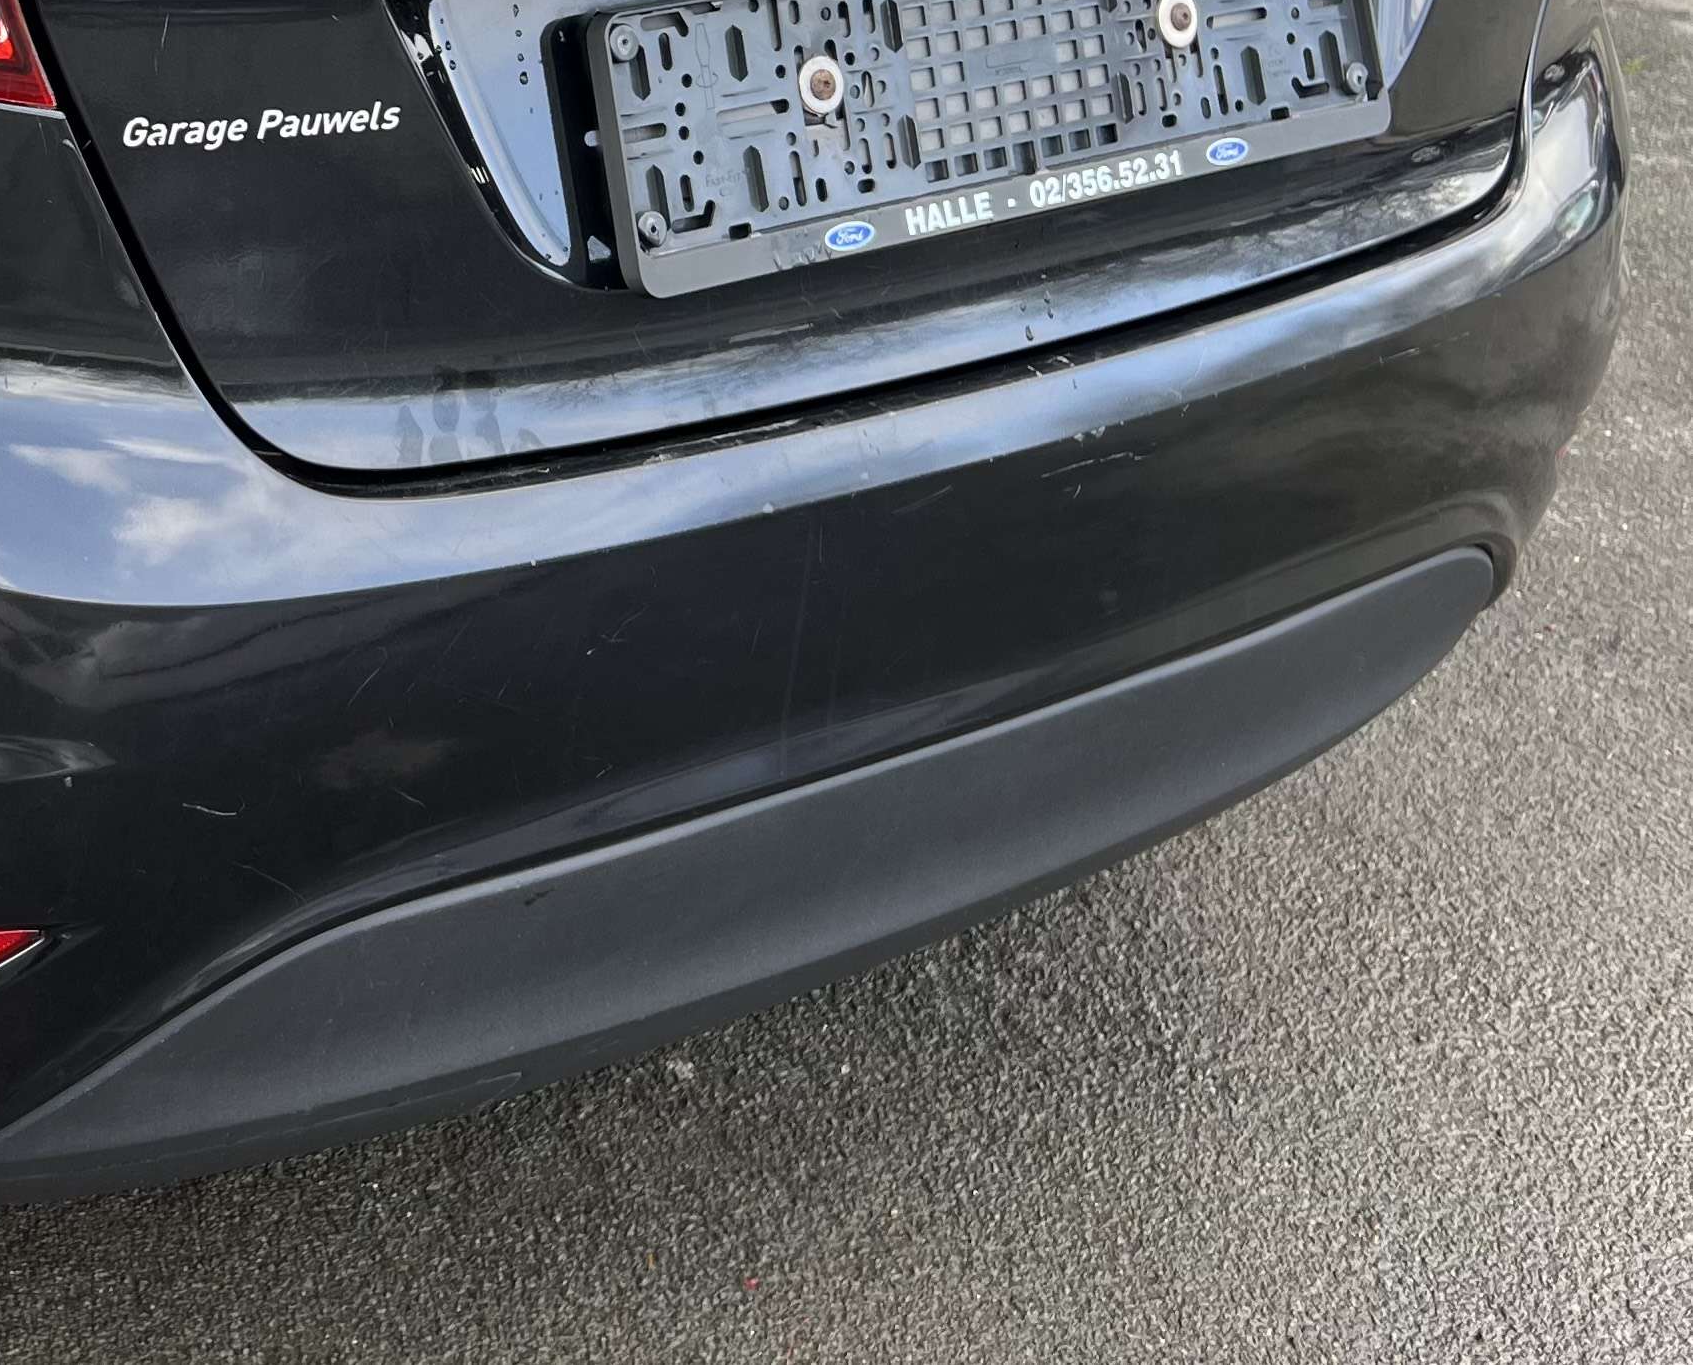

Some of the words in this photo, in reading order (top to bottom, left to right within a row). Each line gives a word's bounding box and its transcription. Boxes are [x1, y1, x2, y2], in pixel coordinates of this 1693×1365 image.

[122, 116, 249, 151] Garage
[256, 100, 402, 140] Pauwels
[904, 191, 995, 236] HALLE
[1029, 149, 1184, 209] 02/356.52.31
